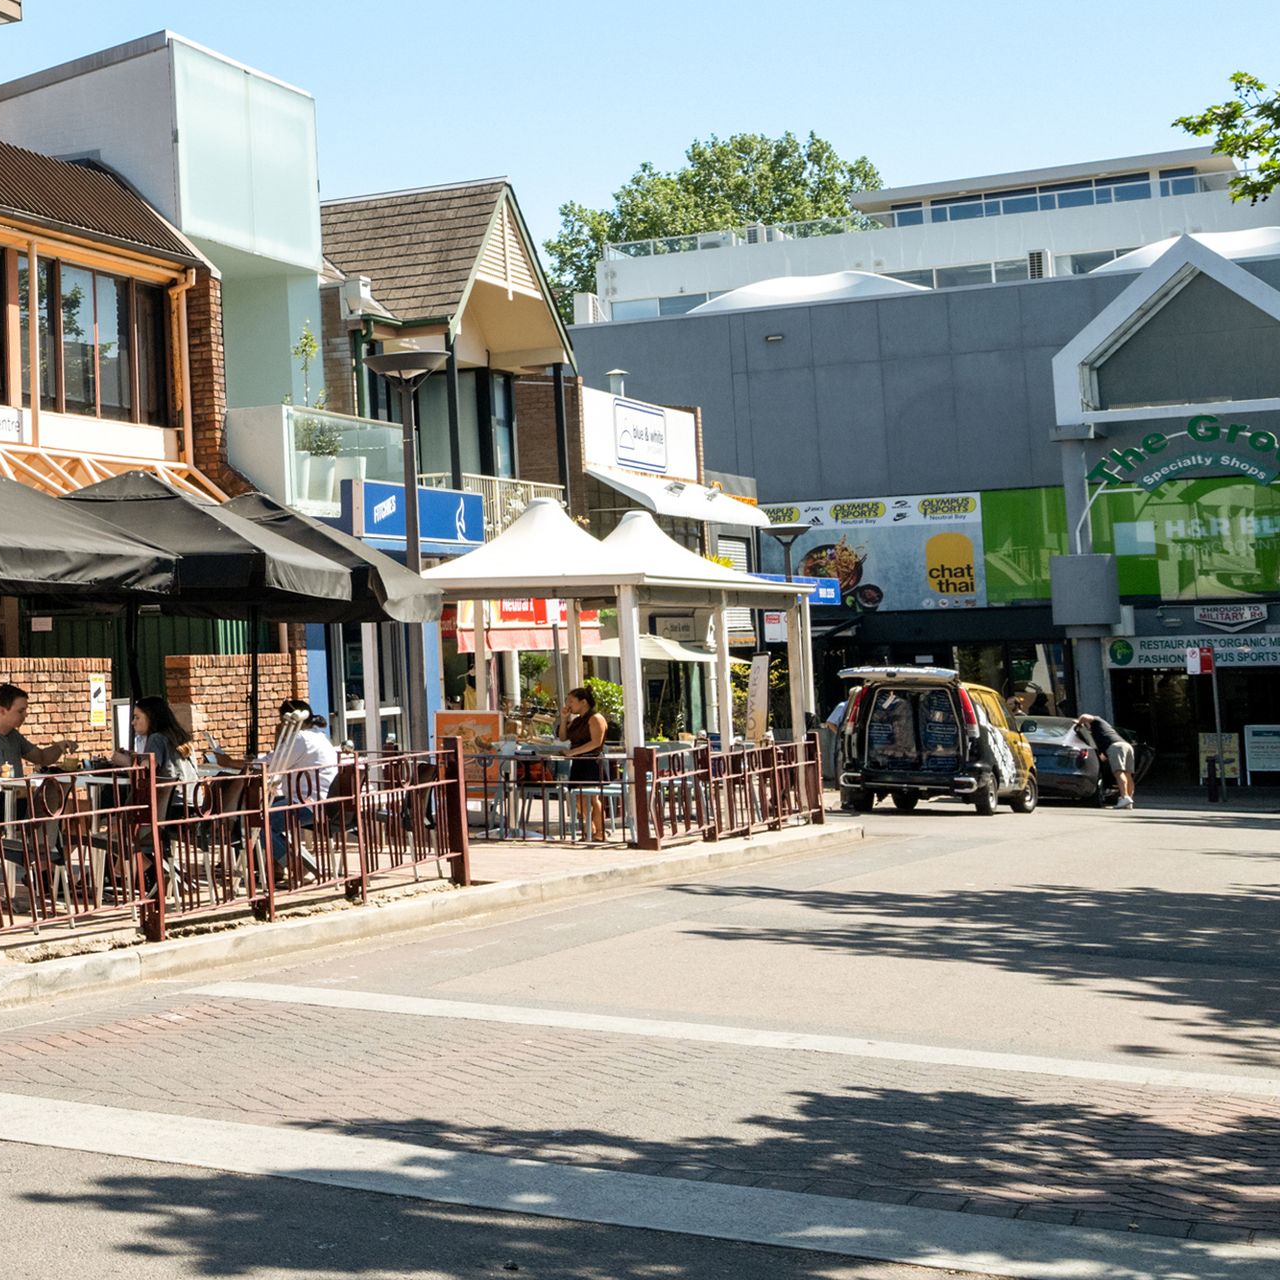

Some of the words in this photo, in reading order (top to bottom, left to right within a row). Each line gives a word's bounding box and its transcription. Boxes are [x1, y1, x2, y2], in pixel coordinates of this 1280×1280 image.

[1085, 431, 1170, 486] The
[1143, 455, 1213, 486] Specialty
[1219, 455, 1267, 480] Shops
[834, 502, 879, 512] OLYMPUS
[922, 497, 969, 507] OLYMPUS
[841, 509, 878, 518] SPORTS
[929, 505, 968, 514] SPORTS
[928, 564, 973, 579] chat
[937, 578, 975, 593] thai
[1140, 638, 1213, 650] RESTAURANTS
[1218, 637, 1267, 648] ORGANIC
[1138, 654, 1185, 664] FASHION
[1237, 651, 1277, 662] SPORTS
[746, 664, 761, 740] LOWERS
